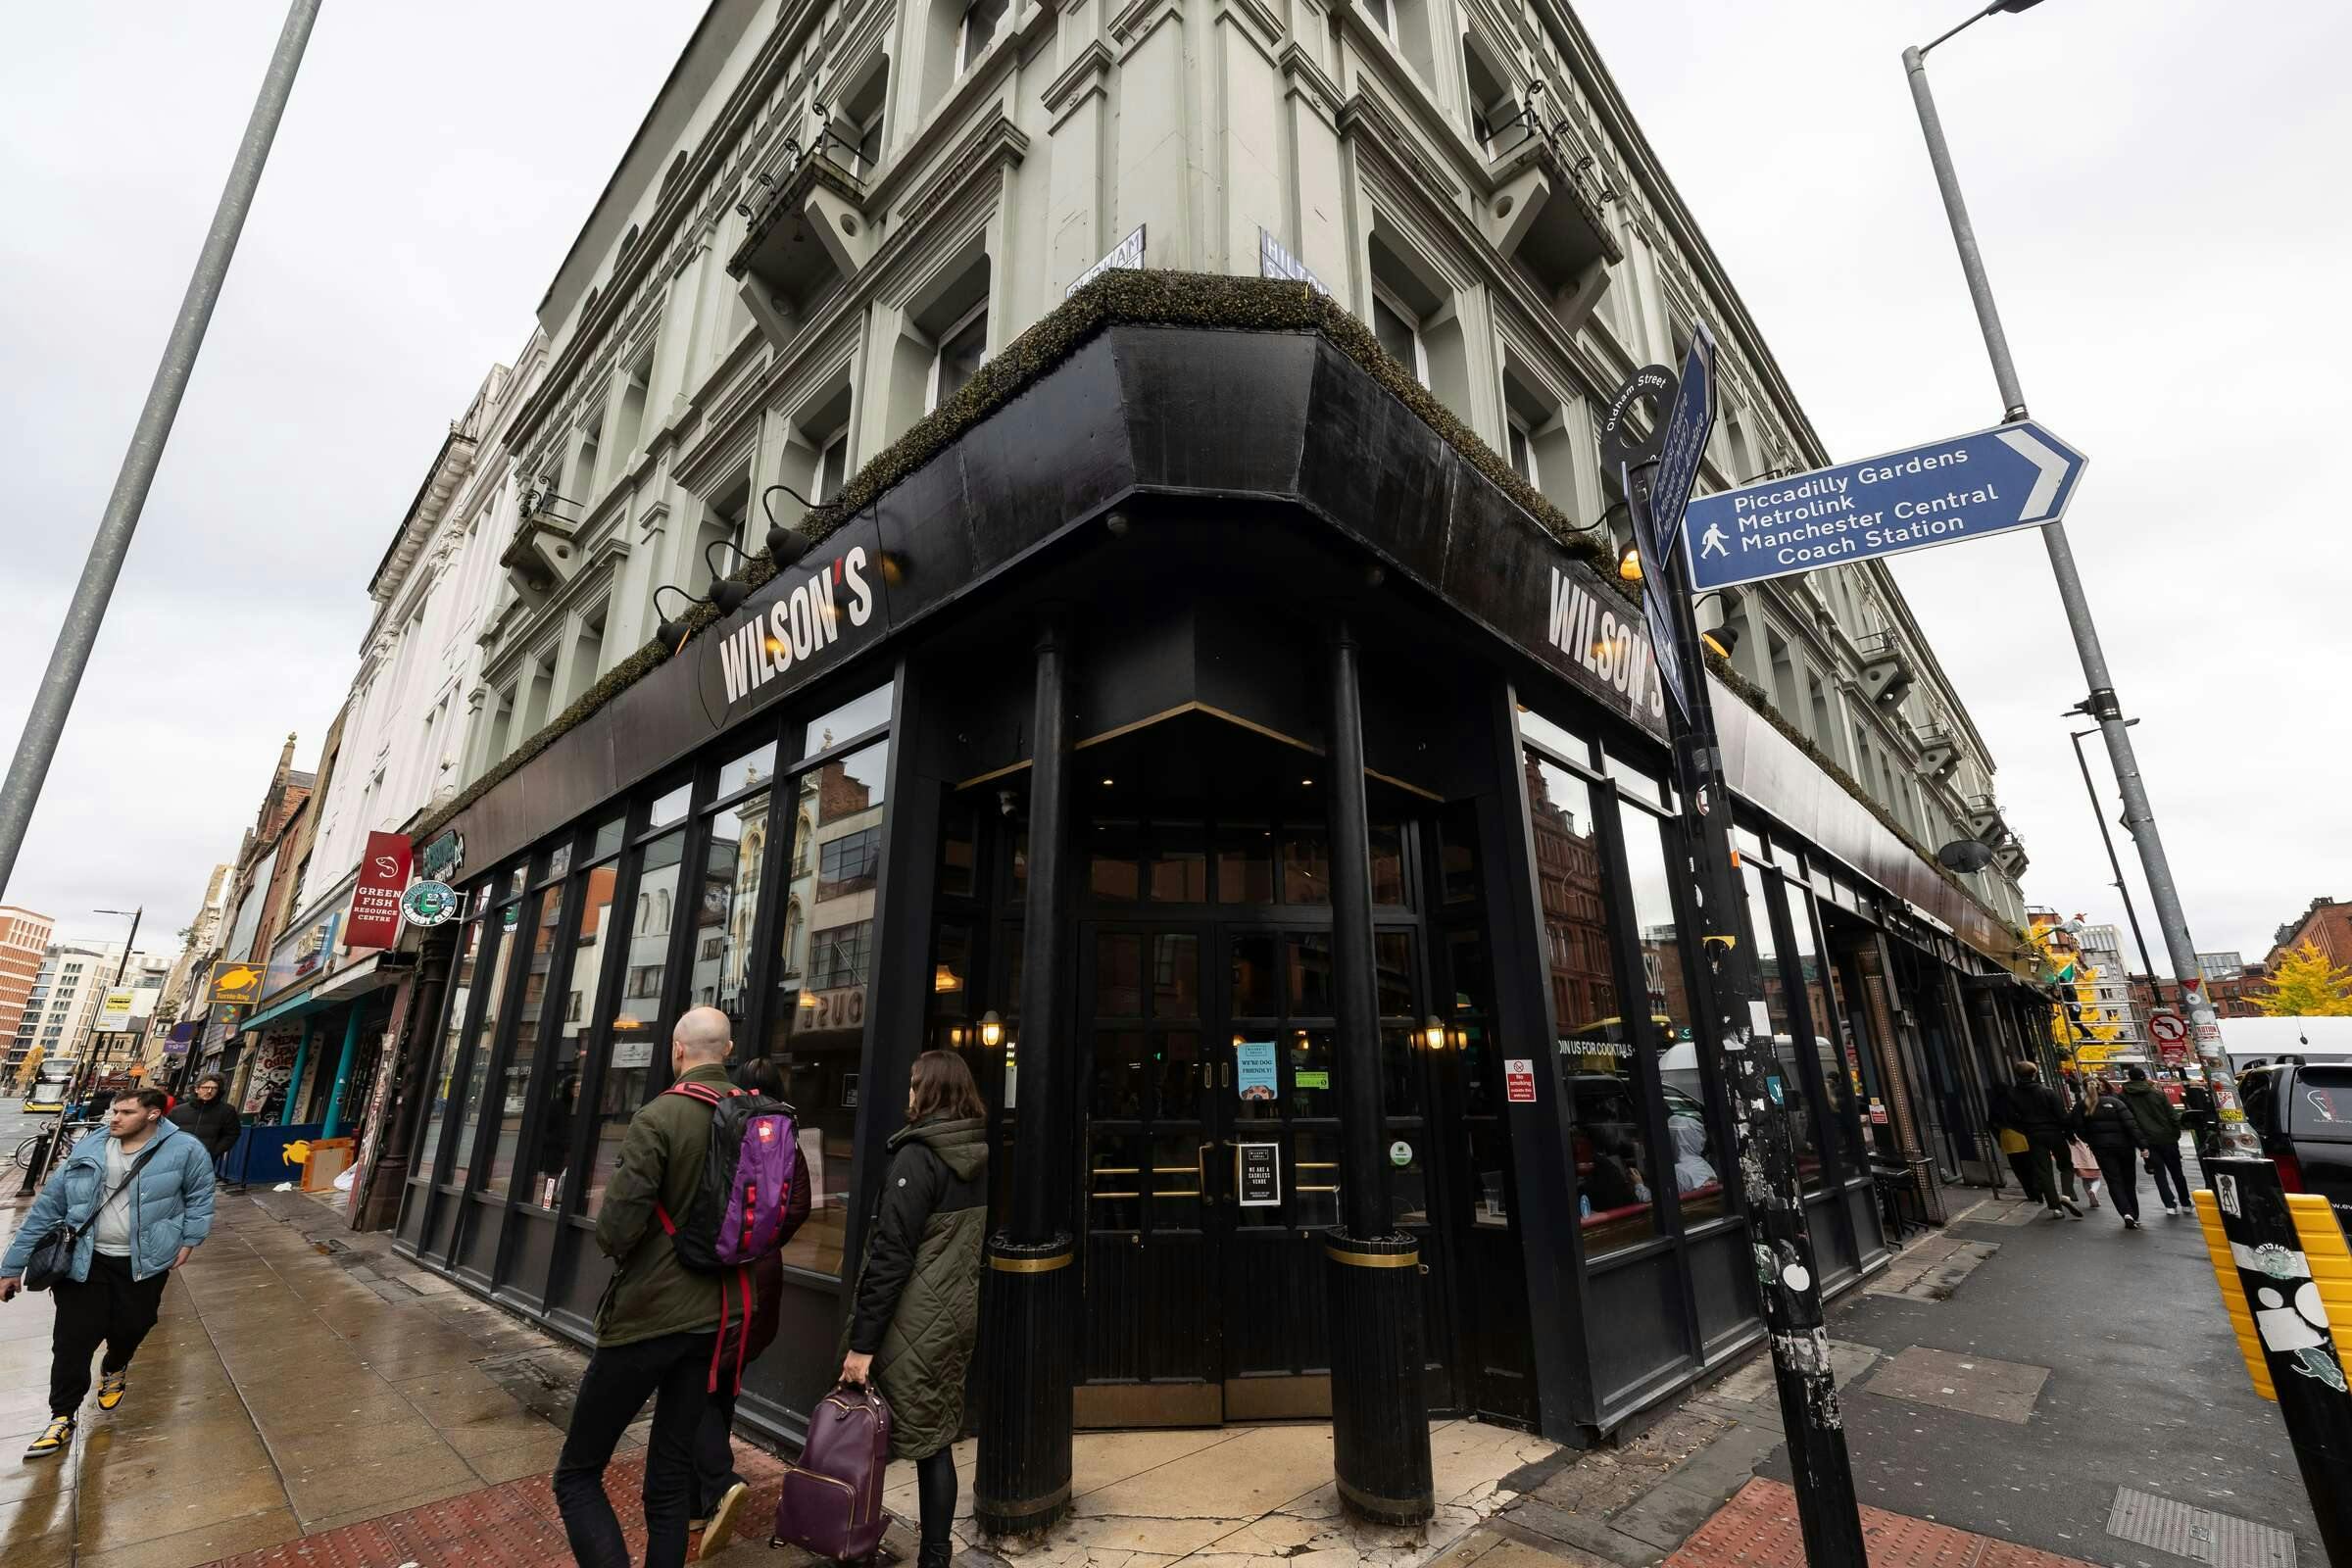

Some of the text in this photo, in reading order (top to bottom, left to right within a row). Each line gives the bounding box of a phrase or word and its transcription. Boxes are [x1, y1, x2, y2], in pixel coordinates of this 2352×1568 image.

[1606, 372, 1668, 432] Oldham Street
[1672, 392, 1690, 443] Centre
[1663, 412, 1704, 534] Manchester Arndale
[1734, 450, 1969, 514] Piccadilly Gardens
[1738, 495, 1855, 532] Metrolink
[1740, 483, 1999, 552] Manchester Central
[1778, 517, 1964, 565] Coach Station
[720, 546, 872, 704] WILSON'S
[354, 906, 398, 916] RESOURCE
[359, 887, 402, 898] GREEN
[363, 898, 394, 907] FISH
[403, 903, 454, 925] COMEDY CLUB
[1570, 1041, 1582, 1055] US
[1581, 1041, 1596, 1055] FOR
[1596, 1042, 1633, 1057] COCKTAILS
[2254, 1242, 2276, 1254] CLUB
